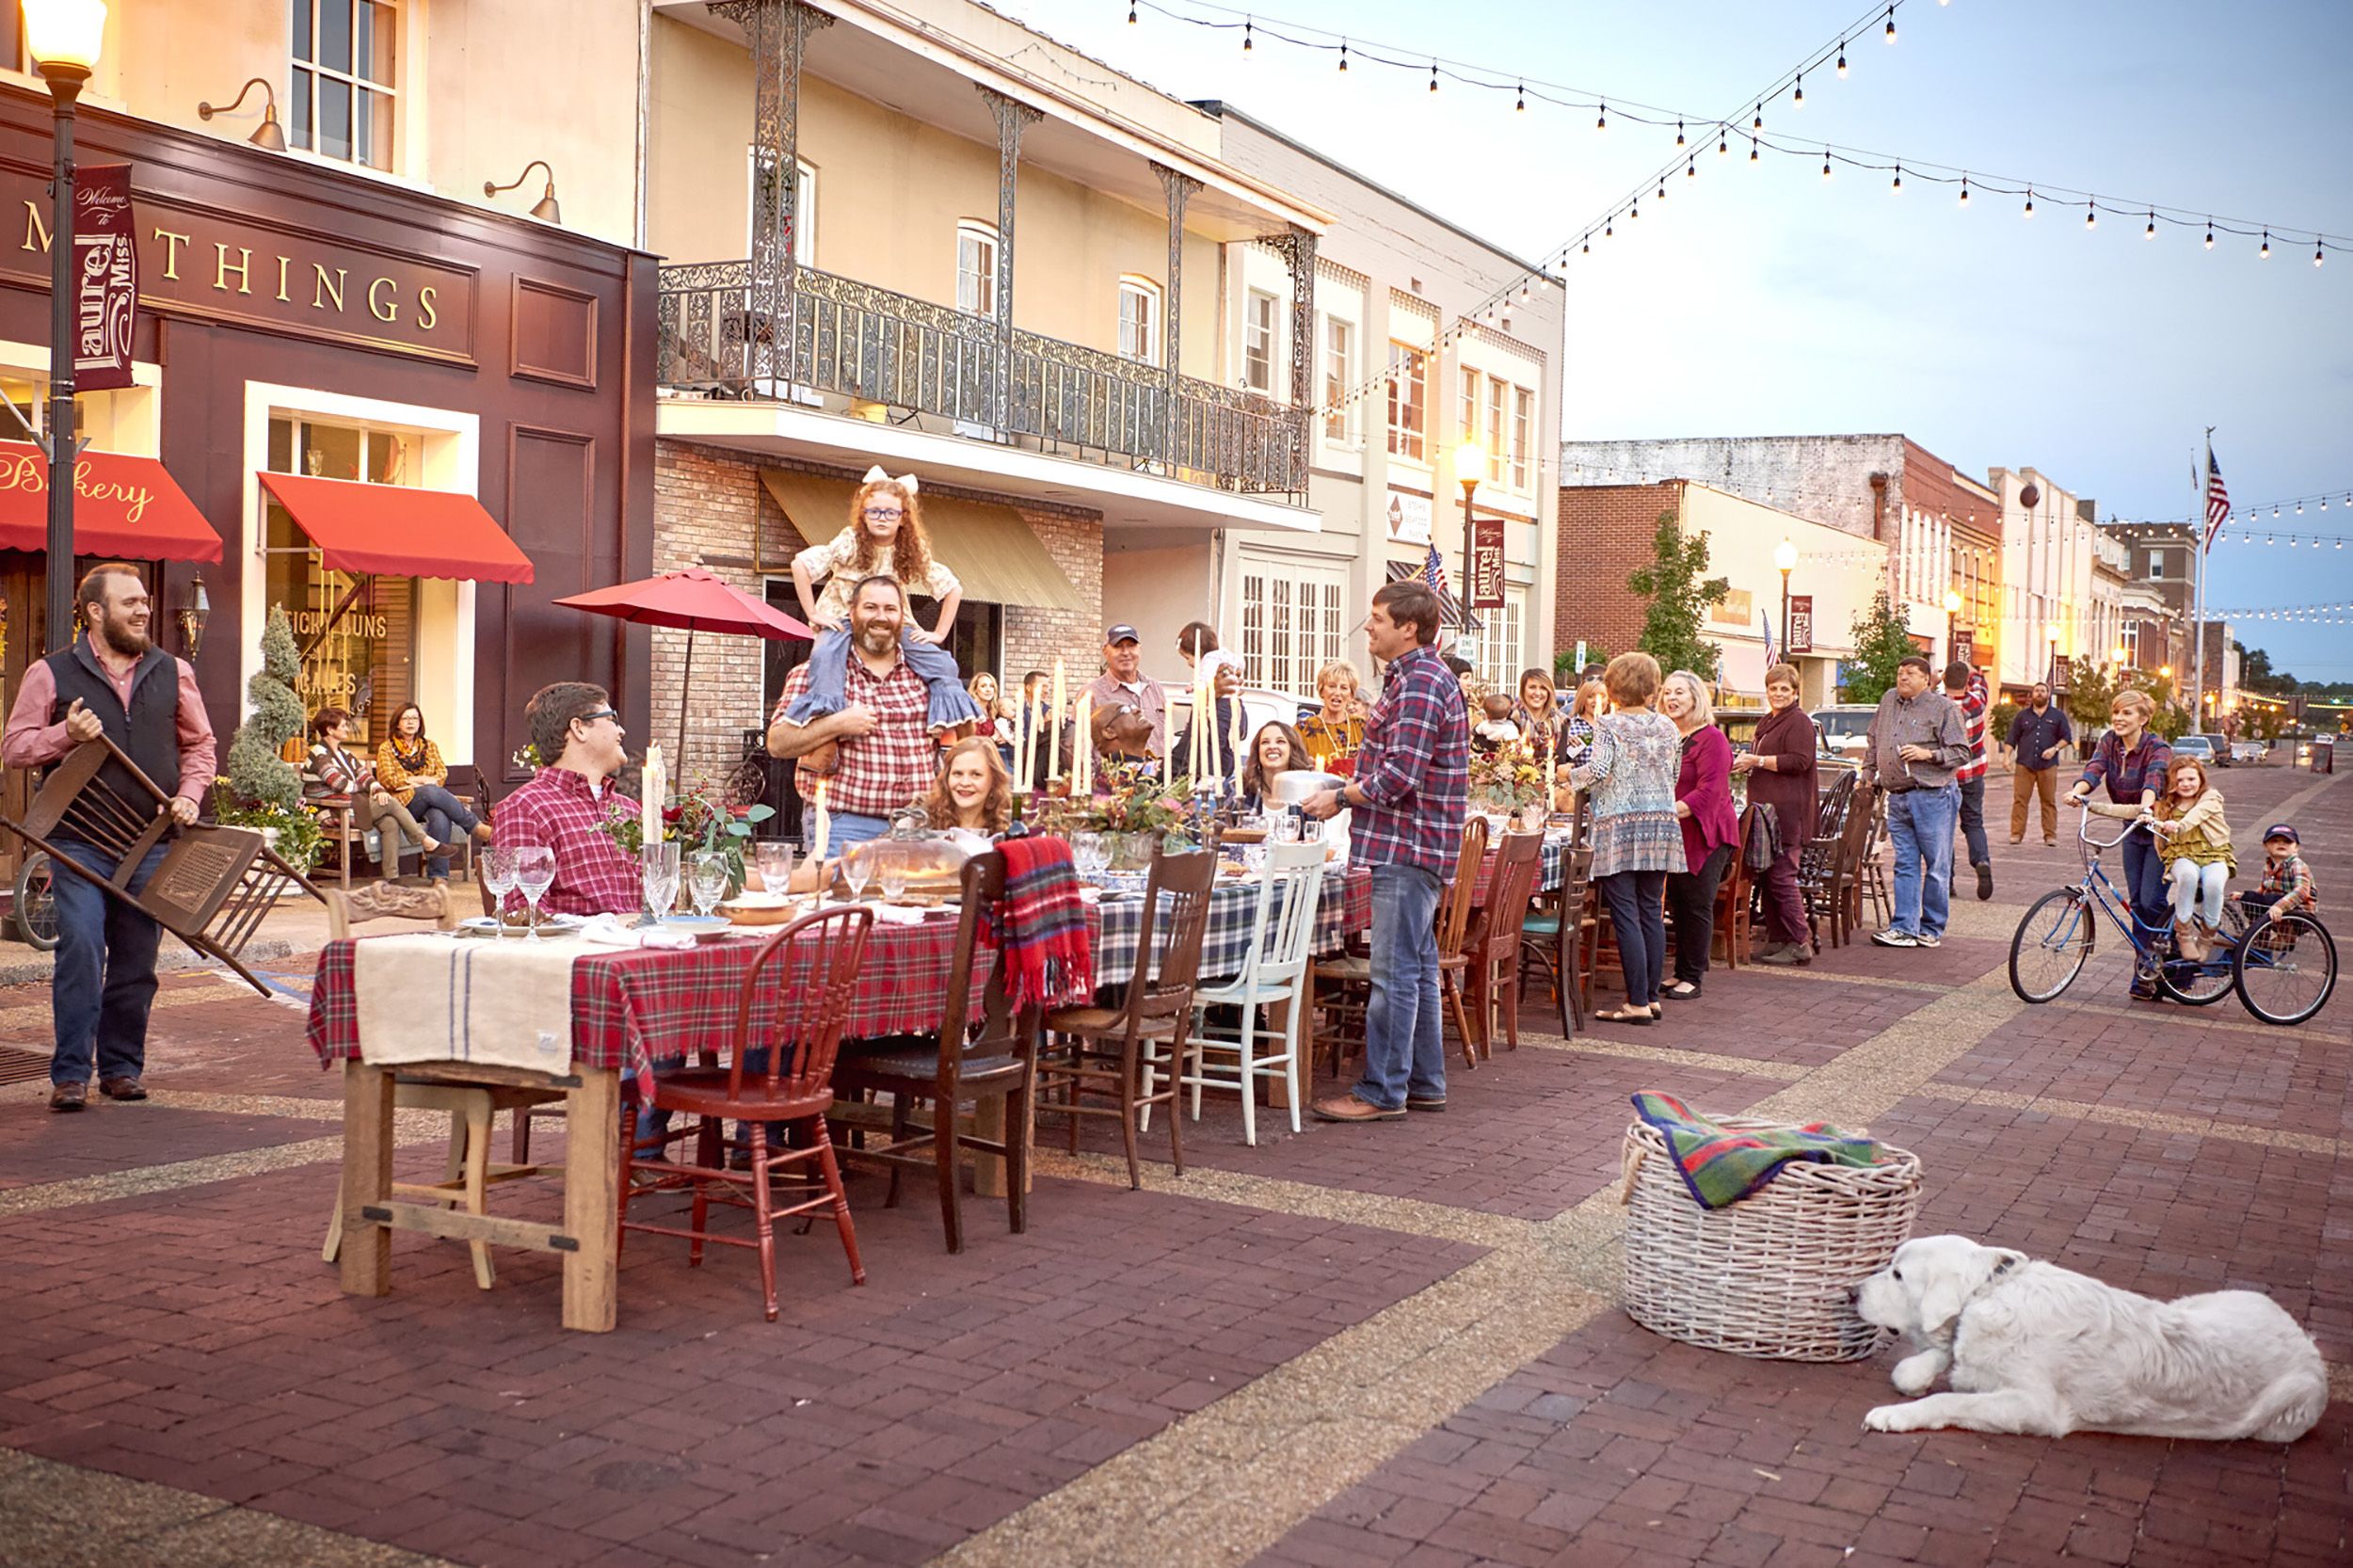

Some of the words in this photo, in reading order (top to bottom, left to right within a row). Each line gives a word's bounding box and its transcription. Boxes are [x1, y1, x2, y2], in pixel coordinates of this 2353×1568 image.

[76, 186, 130, 209] Welcome
[74, 233, 121, 370] Laurel
[0, 452, 155, 523] Bkery
[342, 613, 387, 638] BUNS
